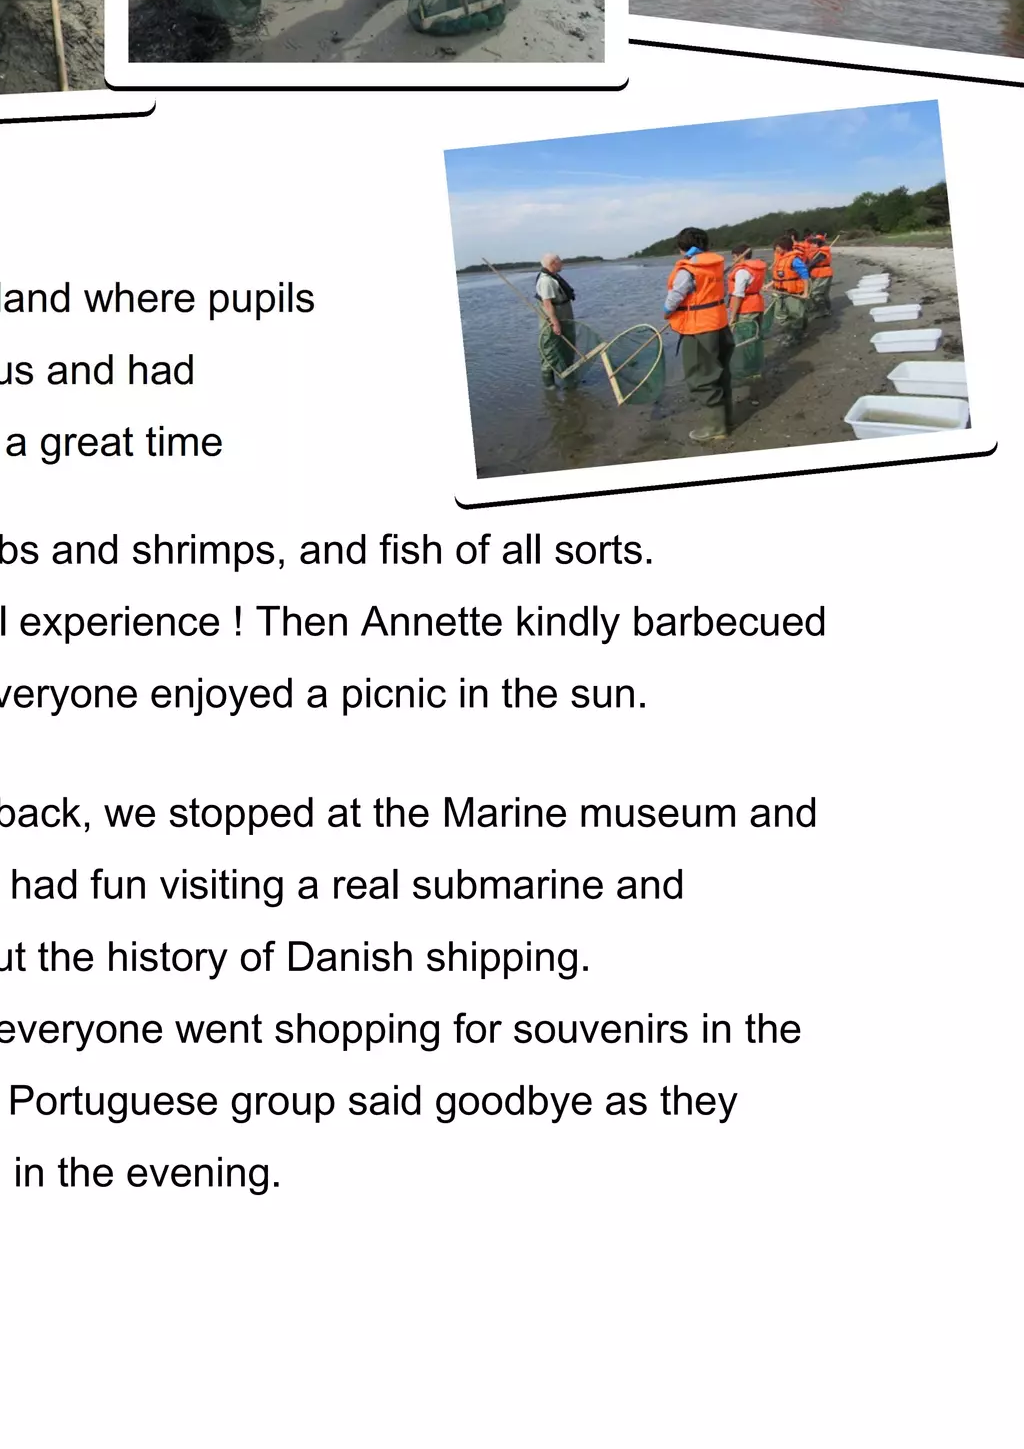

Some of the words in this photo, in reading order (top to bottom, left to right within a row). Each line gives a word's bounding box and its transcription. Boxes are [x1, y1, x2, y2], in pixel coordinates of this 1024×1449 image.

[84, 282, 195, 313] where
[210, 282, 314, 320] pupils
[48, 354, 113, 385] and
[129, 354, 193, 385] had
[6, 434, 26, 456] a
[41, 427, 133, 465] great
[146, 426, 222, 456] time
[53, 534, 117, 564] and
[133, 534, 284, 572] shrimps,
[300, 534, 365, 564] and
[380, 533, 441, 564] fish
[456, 533, 491, 564] of
[503, 533, 540, 564] all
[555, 535, 651, 564] sorts.
[20, 606, 219, 644] experience
[256, 606, 347, 636] Then
[361, 606, 502, 636] Annette
[518, 605, 620, 644] kindly
[634, 606, 824, 636] barbecued
[151, 678, 292, 716] enjoyed
[307, 685, 327, 708] a
[343, 678, 446, 716] picnic
[460, 678, 487, 708] in
[502, 678, 557, 708] the
[571, 685, 645, 708] sun.
[104, 805, 155, 827] we
[170, 797, 313, 835] stopped
[328, 798, 361, 827] at
[373, 797, 429, 827] the
[445, 797, 566, 827] Marine
[581, 805, 735, 827] museum
[751, 797, 815, 827] and
[12, 869, 76, 899] had
[91, 868, 145, 899] fun
[160, 869, 283, 907] visiting
[298, 876, 318, 899] a
[334, 869, 398, 899] real
[413, 869, 603, 899] submarine
[617, 869, 682, 899] and
[38, 941, 93, 972] the
[109, 941, 227, 980] history
[241, 941, 275, 971] of
[289, 941, 412, 972] Danish
[427, 941, 588, 980] shipping.
[175, 1014, 262, 1043] went
[275, 1013, 439, 1052] shopping
[454, 1012, 502, 1043] for
[514, 1013, 688, 1043] souvenirs
[703, 1013, 730, 1043] in
[745, 1013, 800, 1043] the
[11, 1085, 217, 1123] Portuguese
[232, 1092, 335, 1123] group
[349, 1085, 420, 1115] said
[436, 1085, 592, 1123] goodbye
[606, 1092, 647, 1115] as
[660, 1085, 738, 1123] they
[16, 1157, 43, 1187] in
[58, 1157, 113, 1187] the
[127, 1157, 279, 1195] evening.
